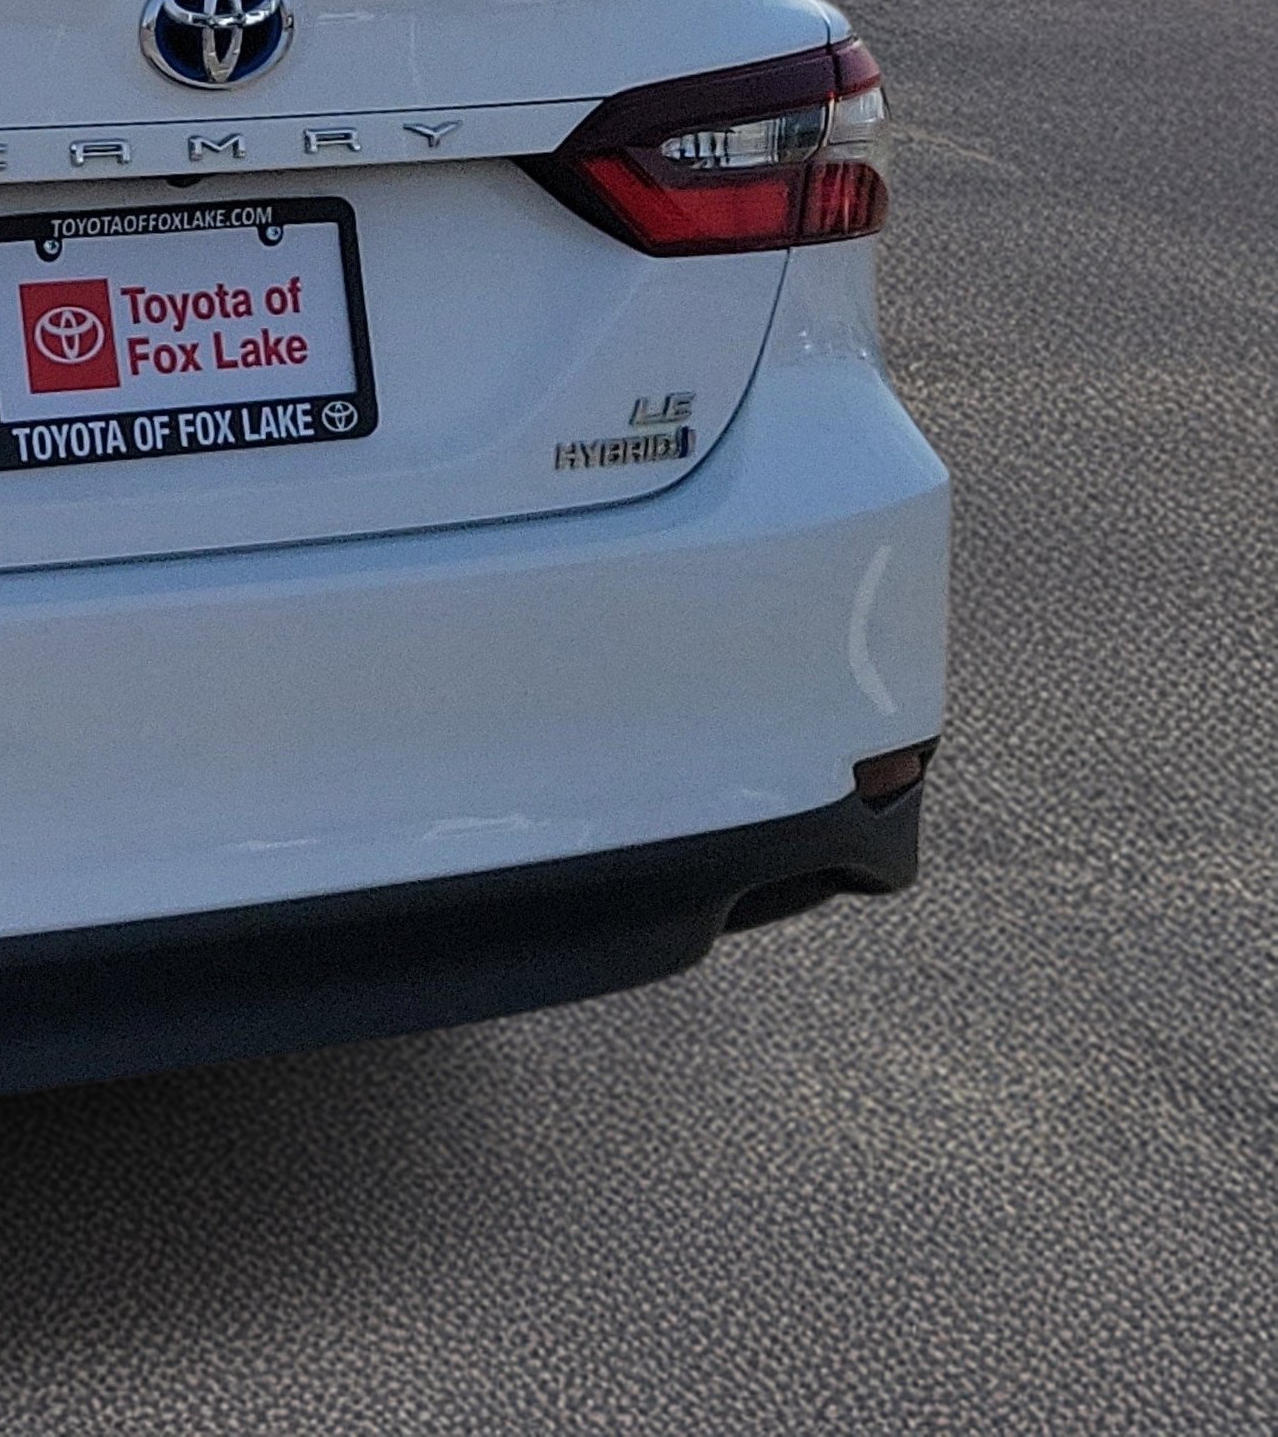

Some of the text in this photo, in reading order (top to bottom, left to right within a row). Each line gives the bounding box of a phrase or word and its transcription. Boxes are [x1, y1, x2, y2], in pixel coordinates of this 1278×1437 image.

[51, 206, 273, 238] TOYOTAOFFOXLAKE.COM
[120, 276, 303, 332] Toyota of
[127, 328, 309, 376] Fox Lake
[629, 391, 695, 425] LE
[12, 403, 316, 462] TOYOTA OF FOX LAKE
[554, 431, 682, 470] HYBRID
